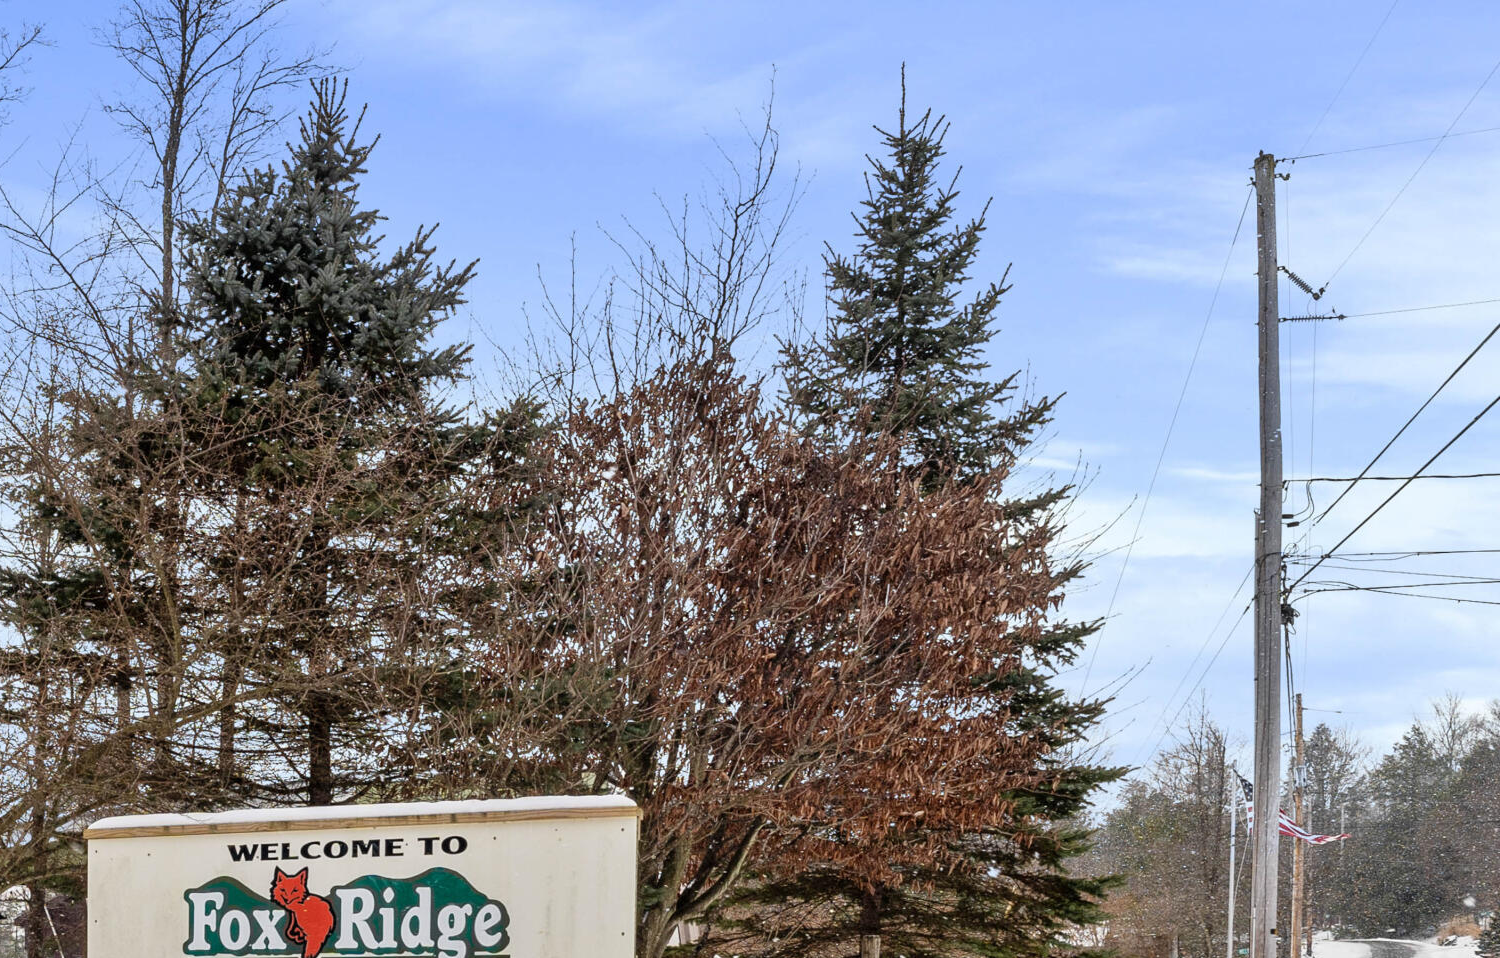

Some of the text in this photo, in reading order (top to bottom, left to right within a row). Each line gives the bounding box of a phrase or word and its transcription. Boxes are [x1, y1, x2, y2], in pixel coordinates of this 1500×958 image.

[227, 835, 469, 863] WELCOME TO
[186, 891, 287, 952] Fox
